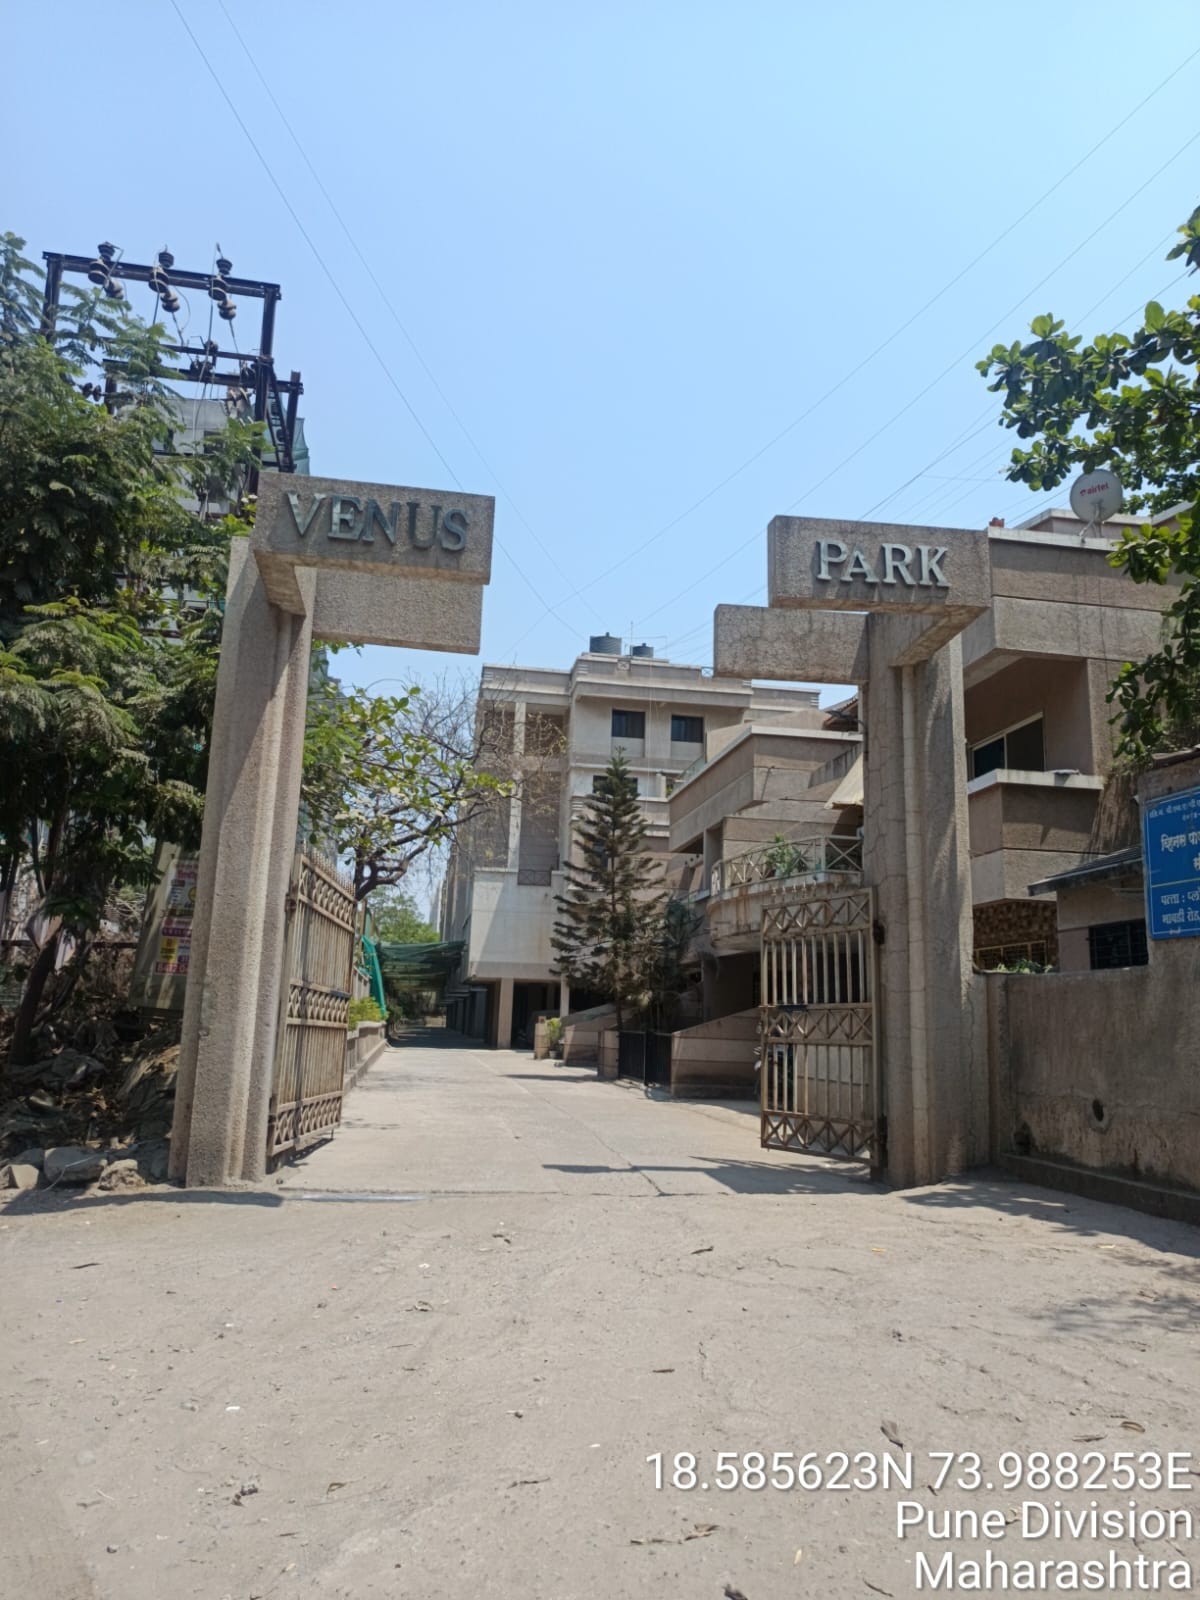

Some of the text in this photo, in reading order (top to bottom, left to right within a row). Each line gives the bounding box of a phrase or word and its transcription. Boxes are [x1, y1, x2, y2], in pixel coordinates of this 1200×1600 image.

[1087, 482, 1109, 494] airtel
[287, 491, 470, 551] VENUS
[816, 539, 950, 588] PARK
